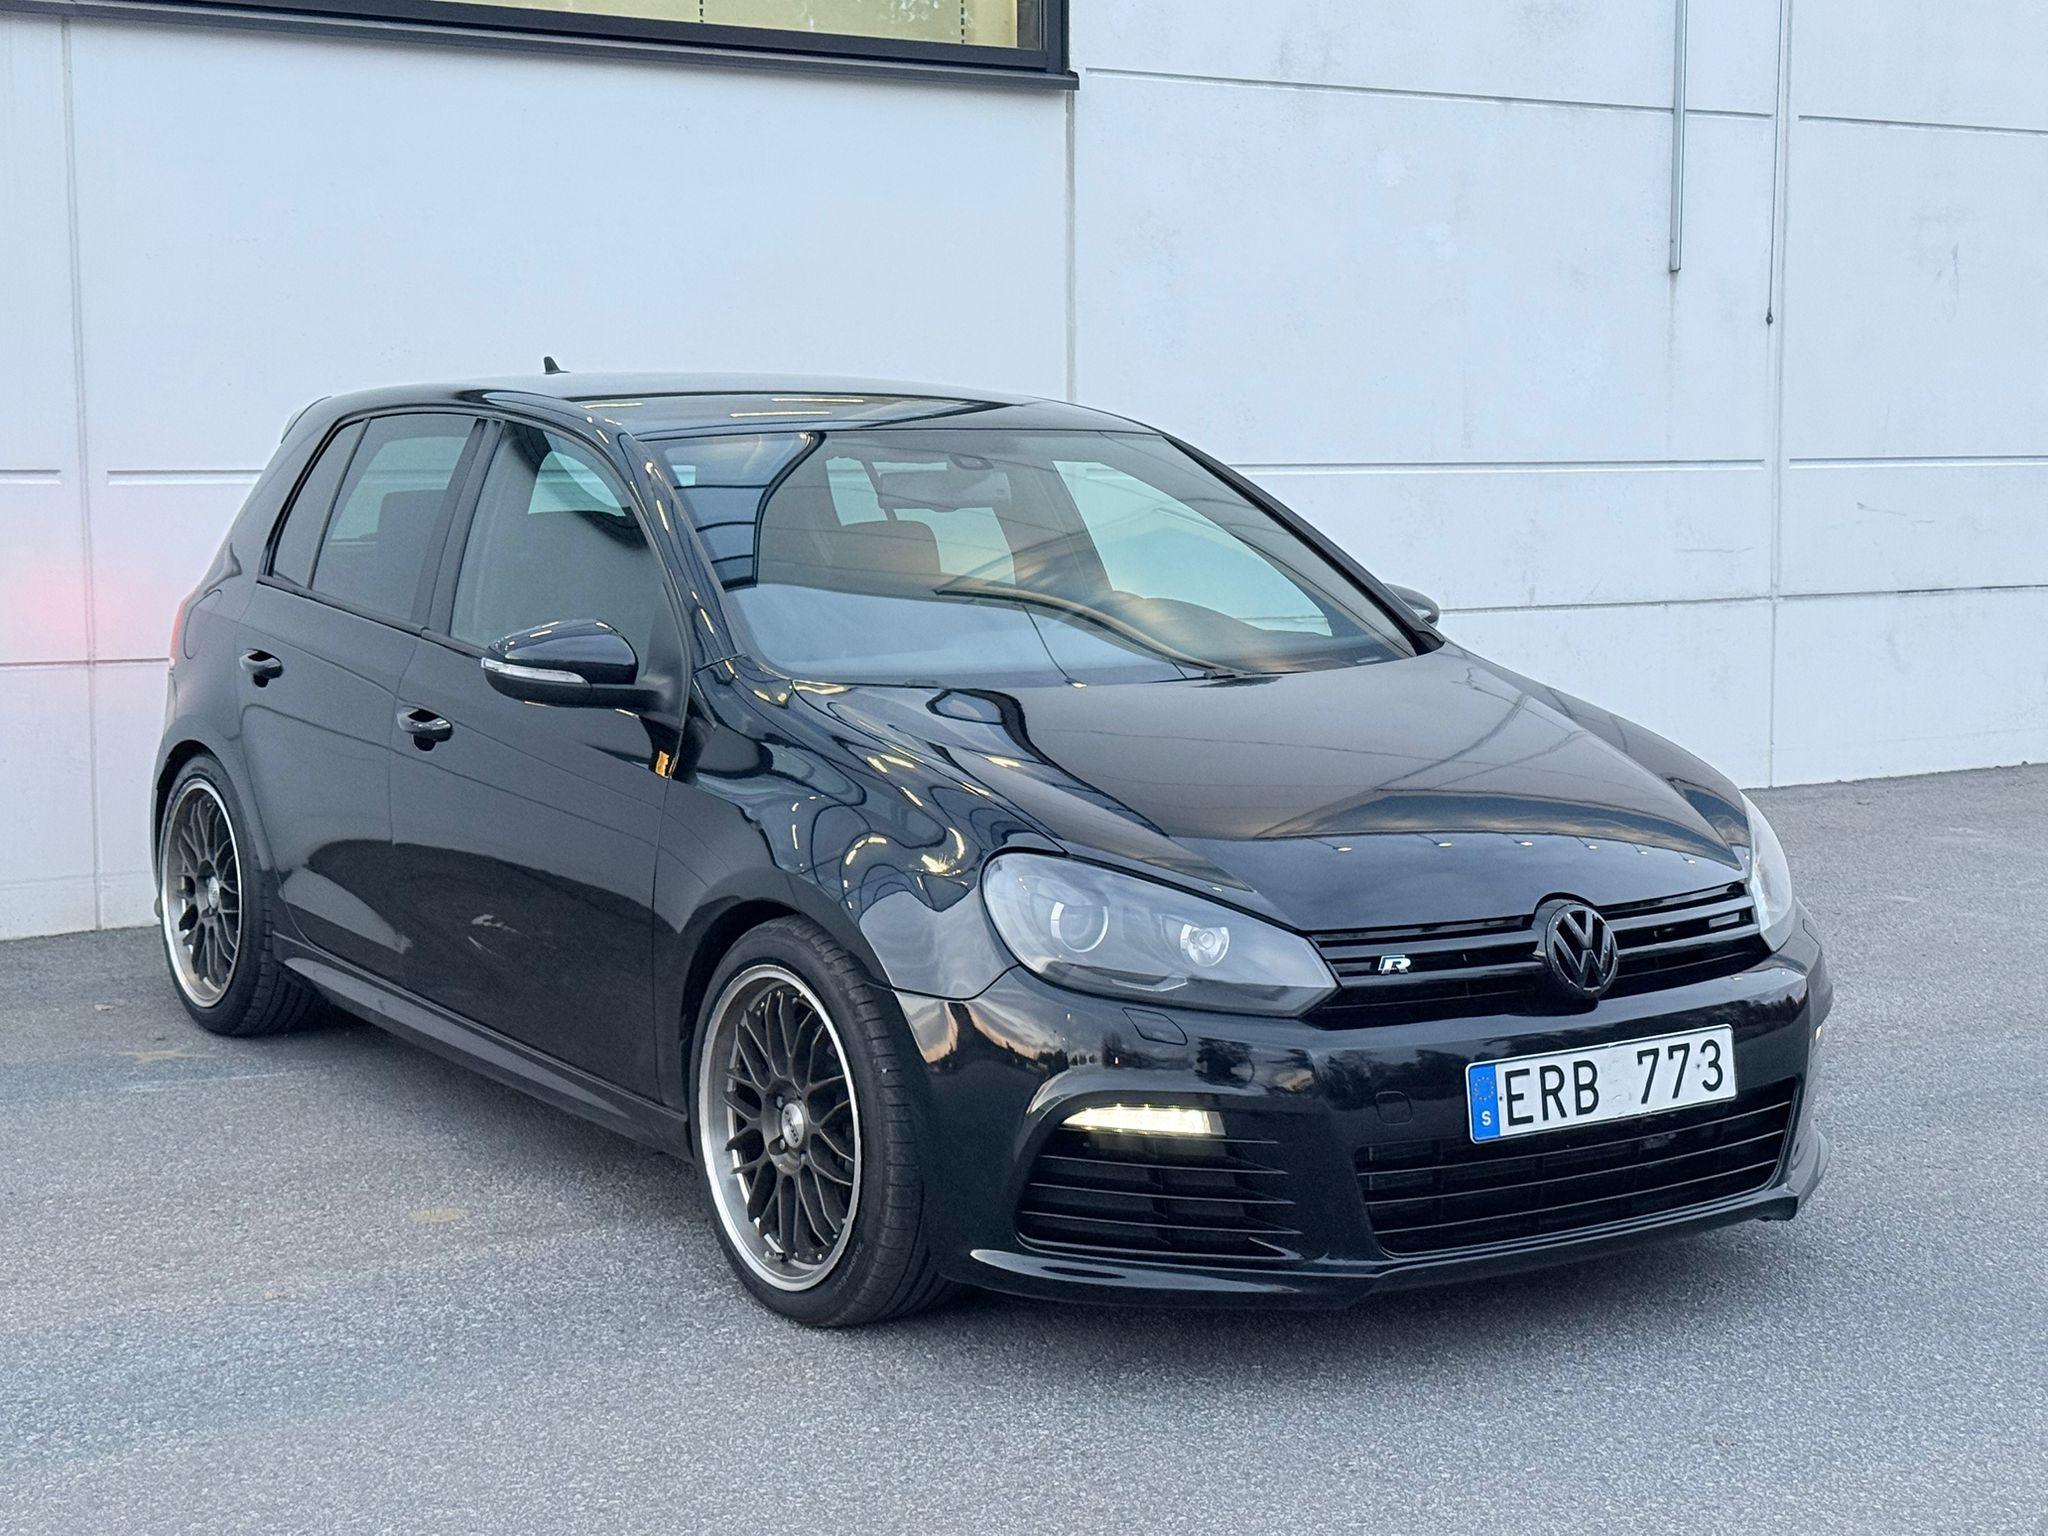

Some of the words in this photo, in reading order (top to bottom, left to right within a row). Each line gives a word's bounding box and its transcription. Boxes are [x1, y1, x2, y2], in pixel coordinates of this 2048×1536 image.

[1378, 954, 1411, 975] R
[1504, 1060, 1600, 1126] ERB
[1636, 1039, 1723, 1104] 773
[1481, 1111, 1492, 1126] S
